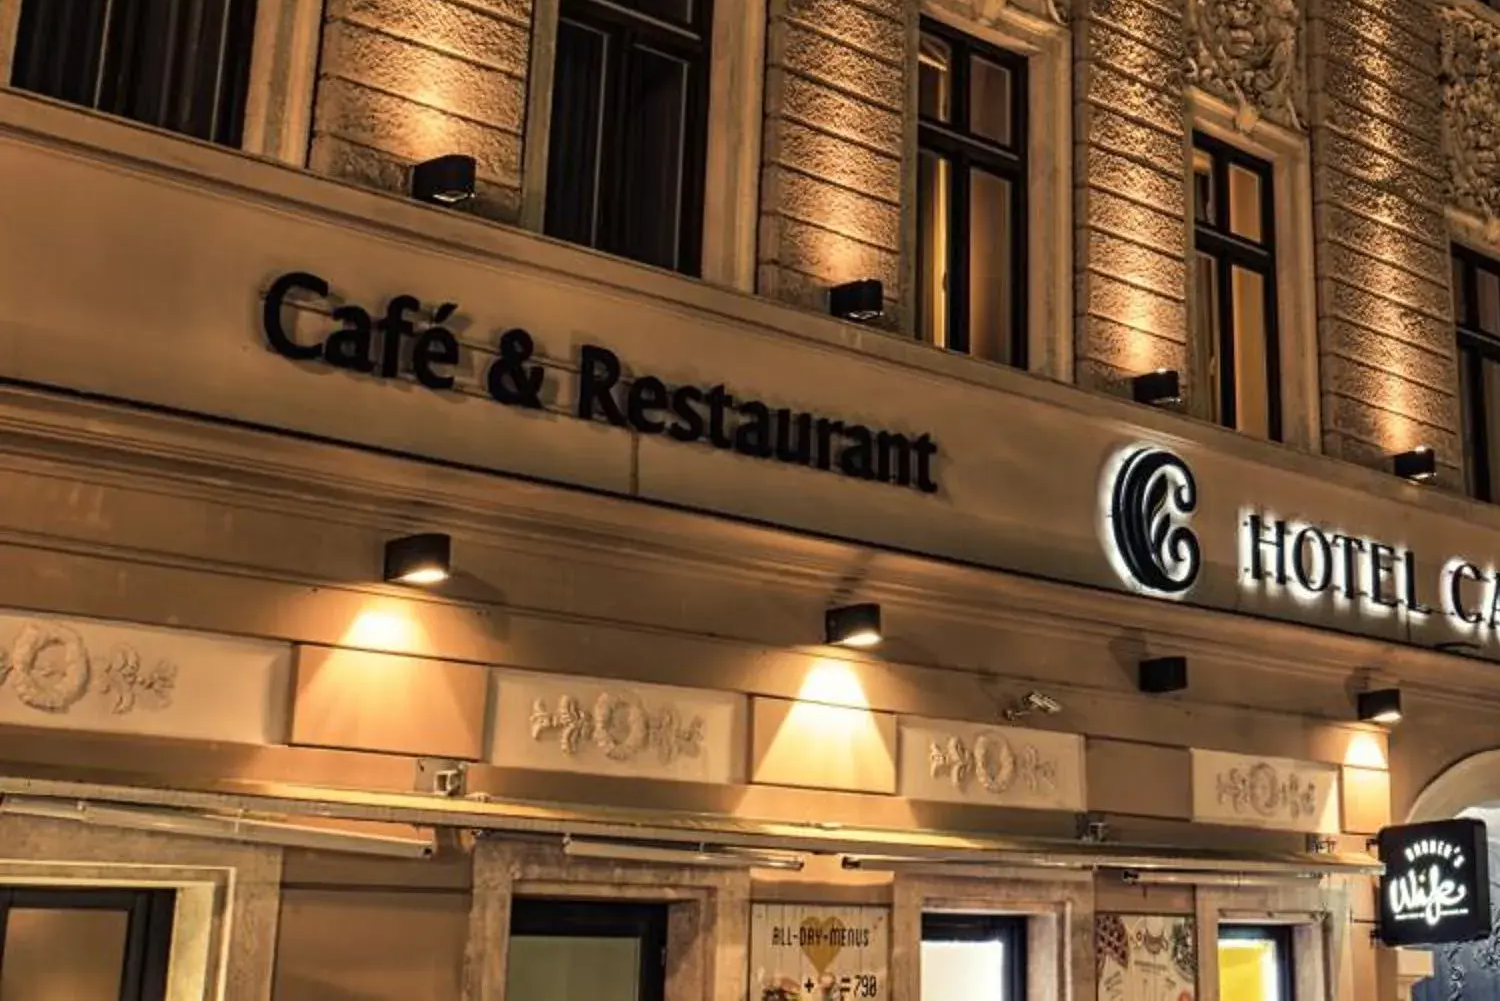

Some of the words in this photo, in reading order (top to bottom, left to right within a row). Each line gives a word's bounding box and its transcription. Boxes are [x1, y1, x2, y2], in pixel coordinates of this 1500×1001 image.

[264, 272, 459, 390] Café
[489, 328, 544, 409] &
[578, 344, 938, 493] Restaurant
[1247, 514, 1432, 616] HOTEL
[1389, 864, 1467, 926] Wife
